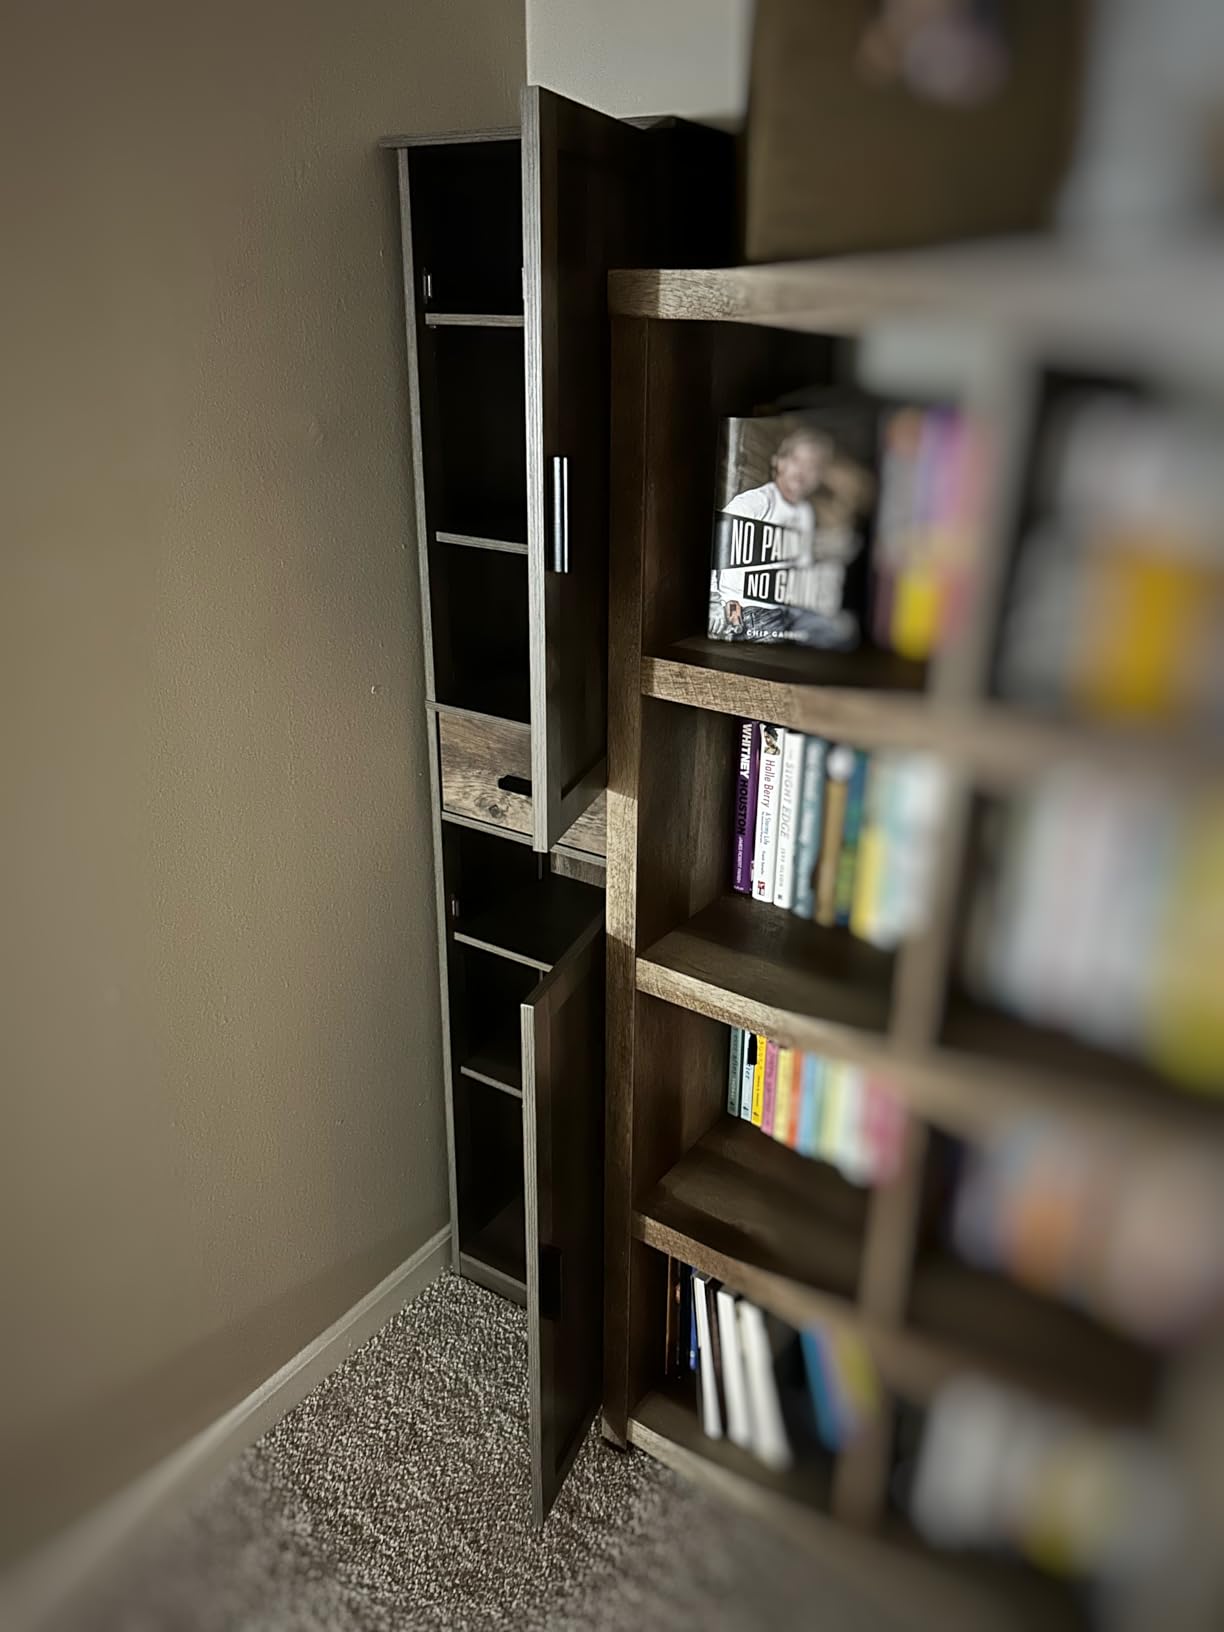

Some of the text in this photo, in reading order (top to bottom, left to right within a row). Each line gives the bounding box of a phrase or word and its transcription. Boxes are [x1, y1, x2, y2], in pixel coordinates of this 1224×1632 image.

[730, 519, 755, 566] NO
[747, 572, 770, 600] NO
[747, 629, 769, 638] CHIP
[738, 723, 752, 835] WHITNEY HOUSTON
[760, 759, 776, 808] Halle Berry
[781, 805, 792, 840] EDGE
